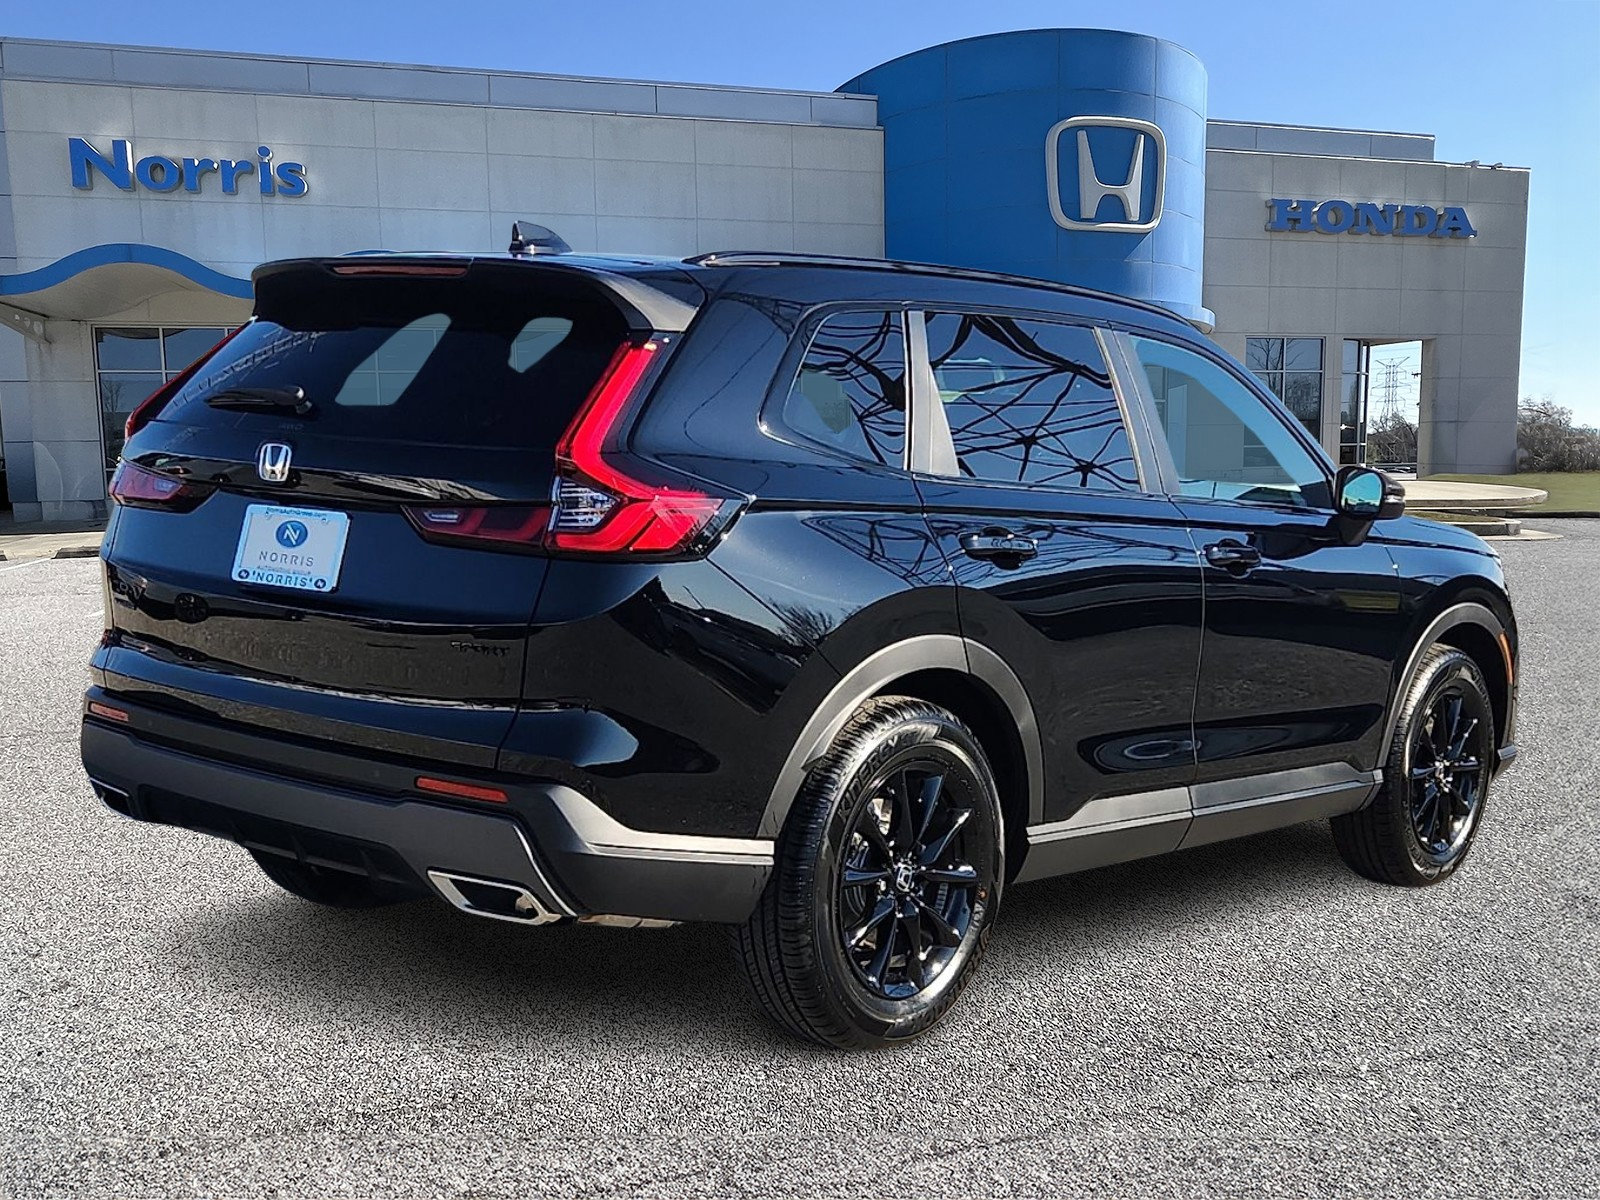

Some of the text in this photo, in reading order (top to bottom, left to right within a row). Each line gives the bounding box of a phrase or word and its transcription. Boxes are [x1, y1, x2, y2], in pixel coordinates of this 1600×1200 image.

[68, 137, 308, 197] Norris
[1266, 198, 1477, 239] HONDA
[259, 551, 314, 567] NORRIS
